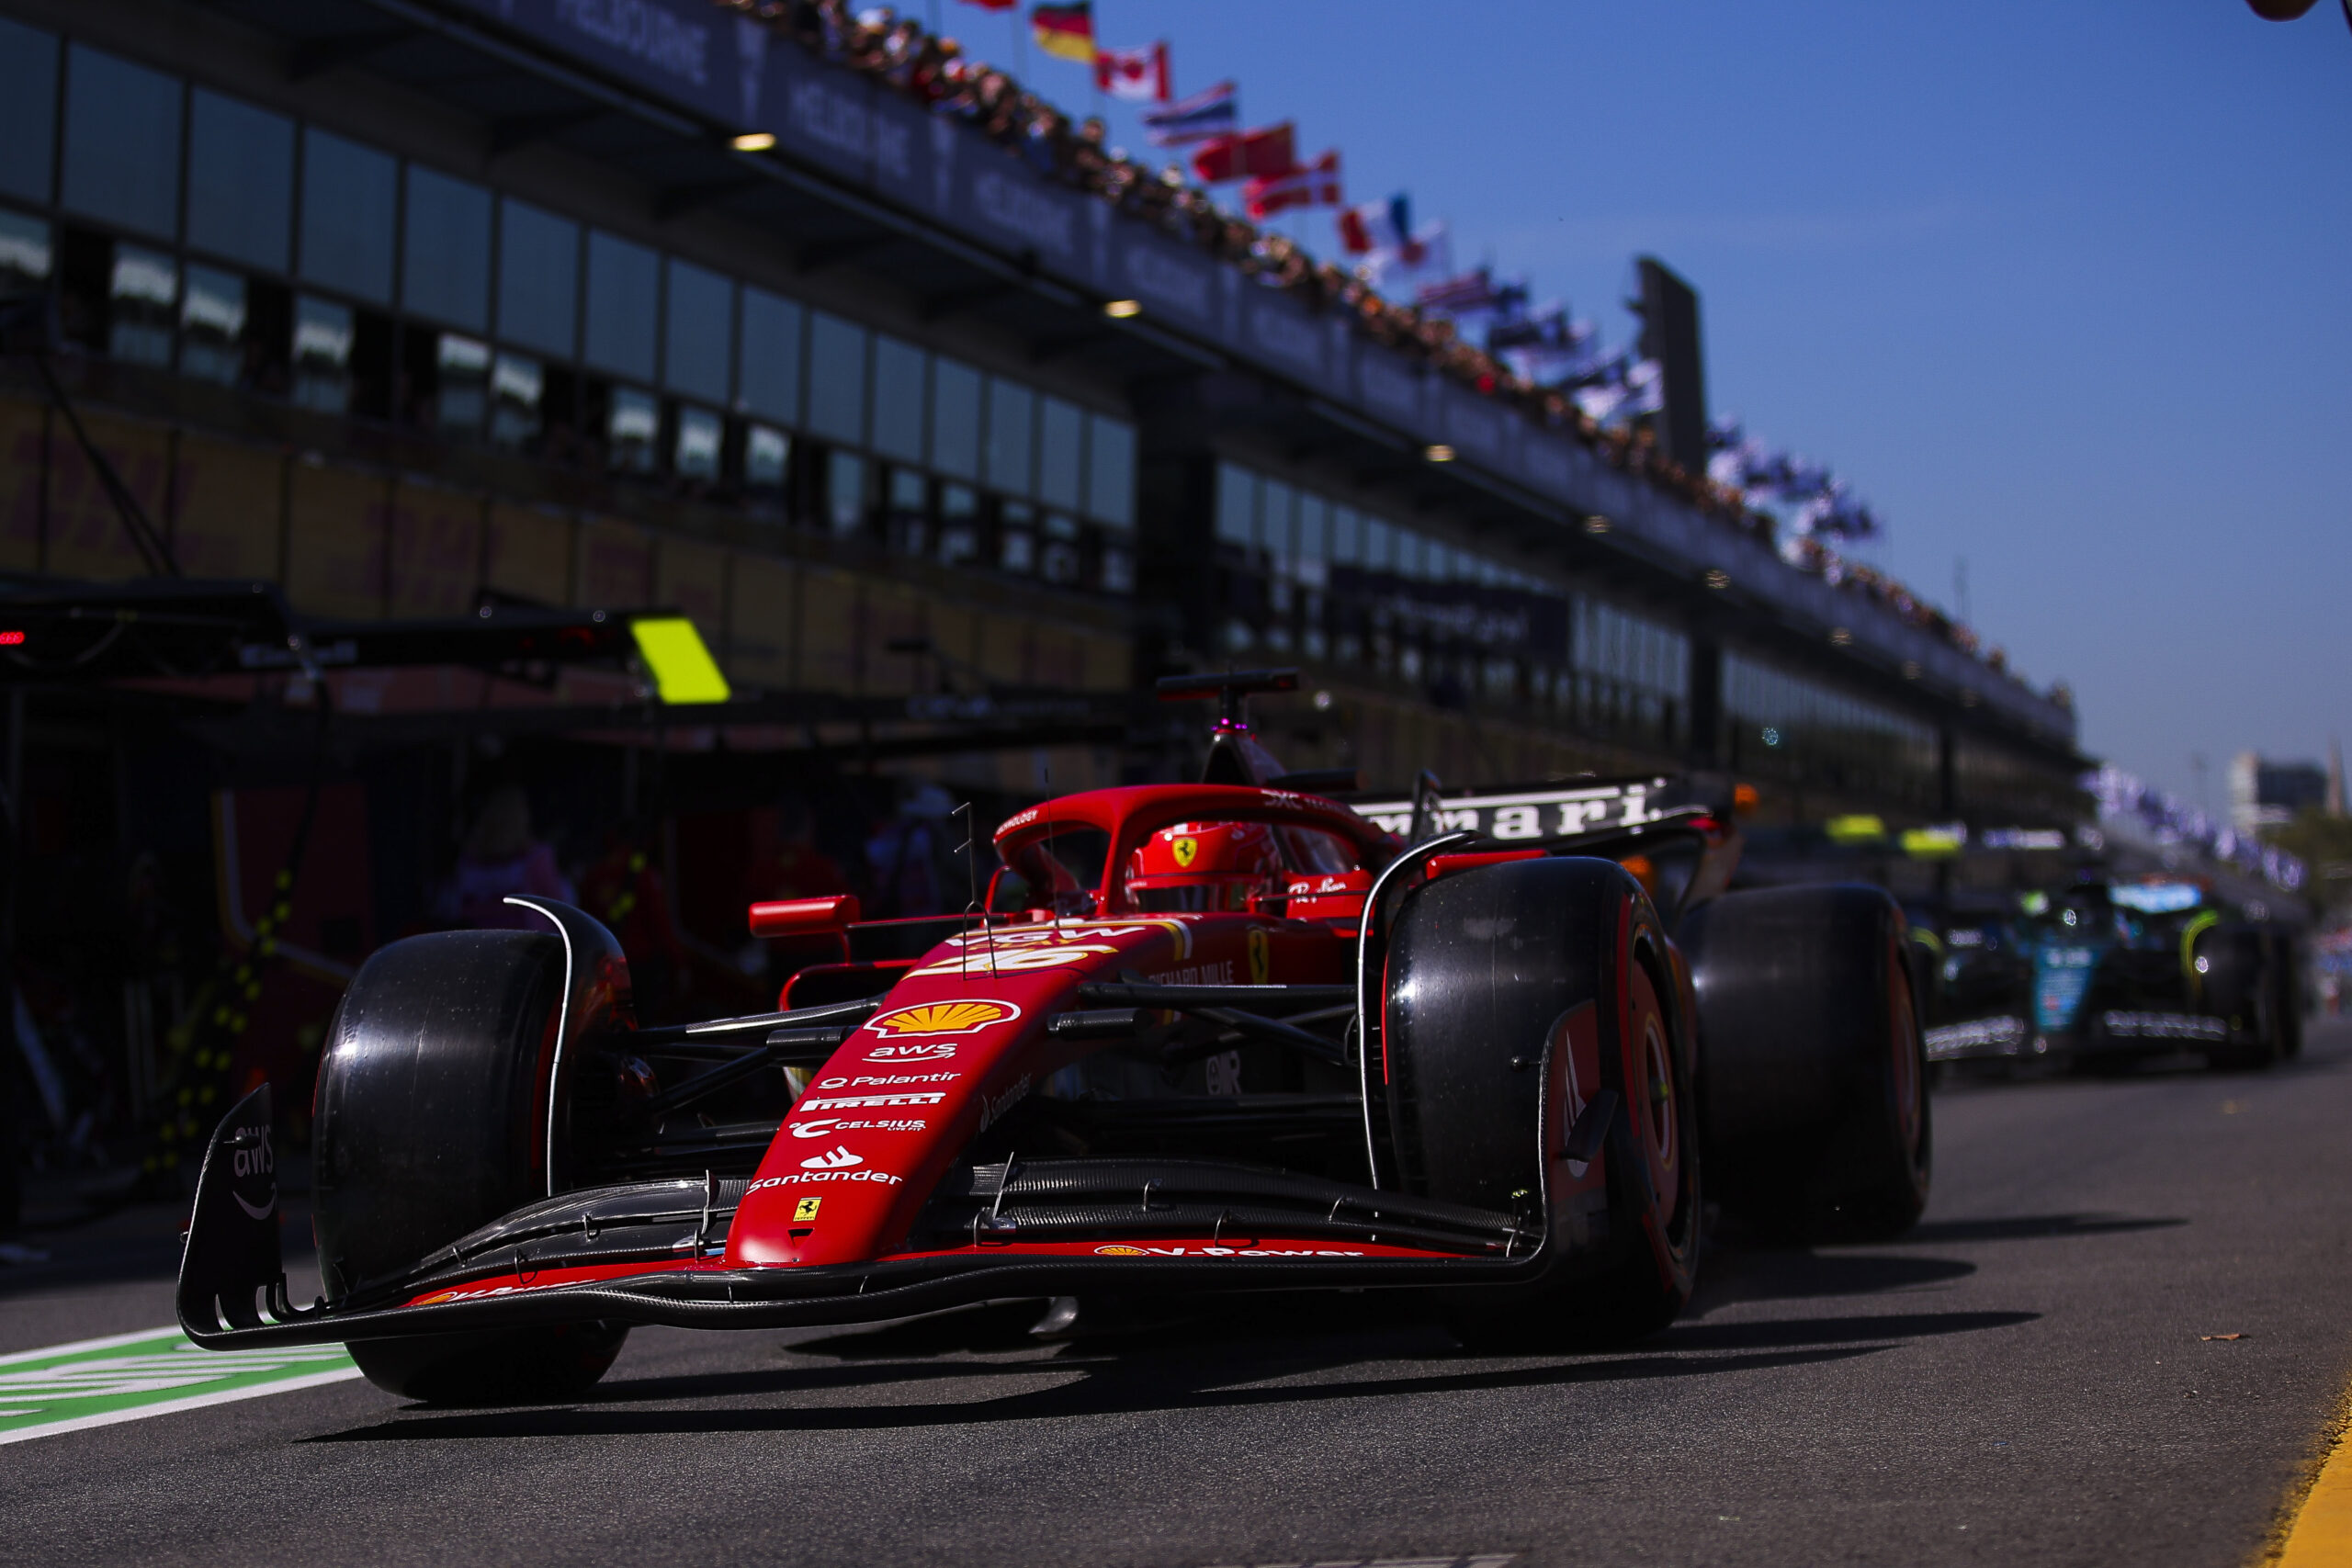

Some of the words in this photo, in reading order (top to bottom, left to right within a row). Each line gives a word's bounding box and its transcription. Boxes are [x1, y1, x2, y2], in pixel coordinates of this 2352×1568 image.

[869, 1043, 958, 1058] aws
[850, 1072, 962, 1088] Palantir
[798, 1091, 947, 1112] PIRELLI
[834, 1120, 926, 1130] CELSIUS
[233, 1123, 274, 1178] aws
[745, 1169, 903, 1196] Santander
[1148, 1247, 1365, 1257] V-Power
